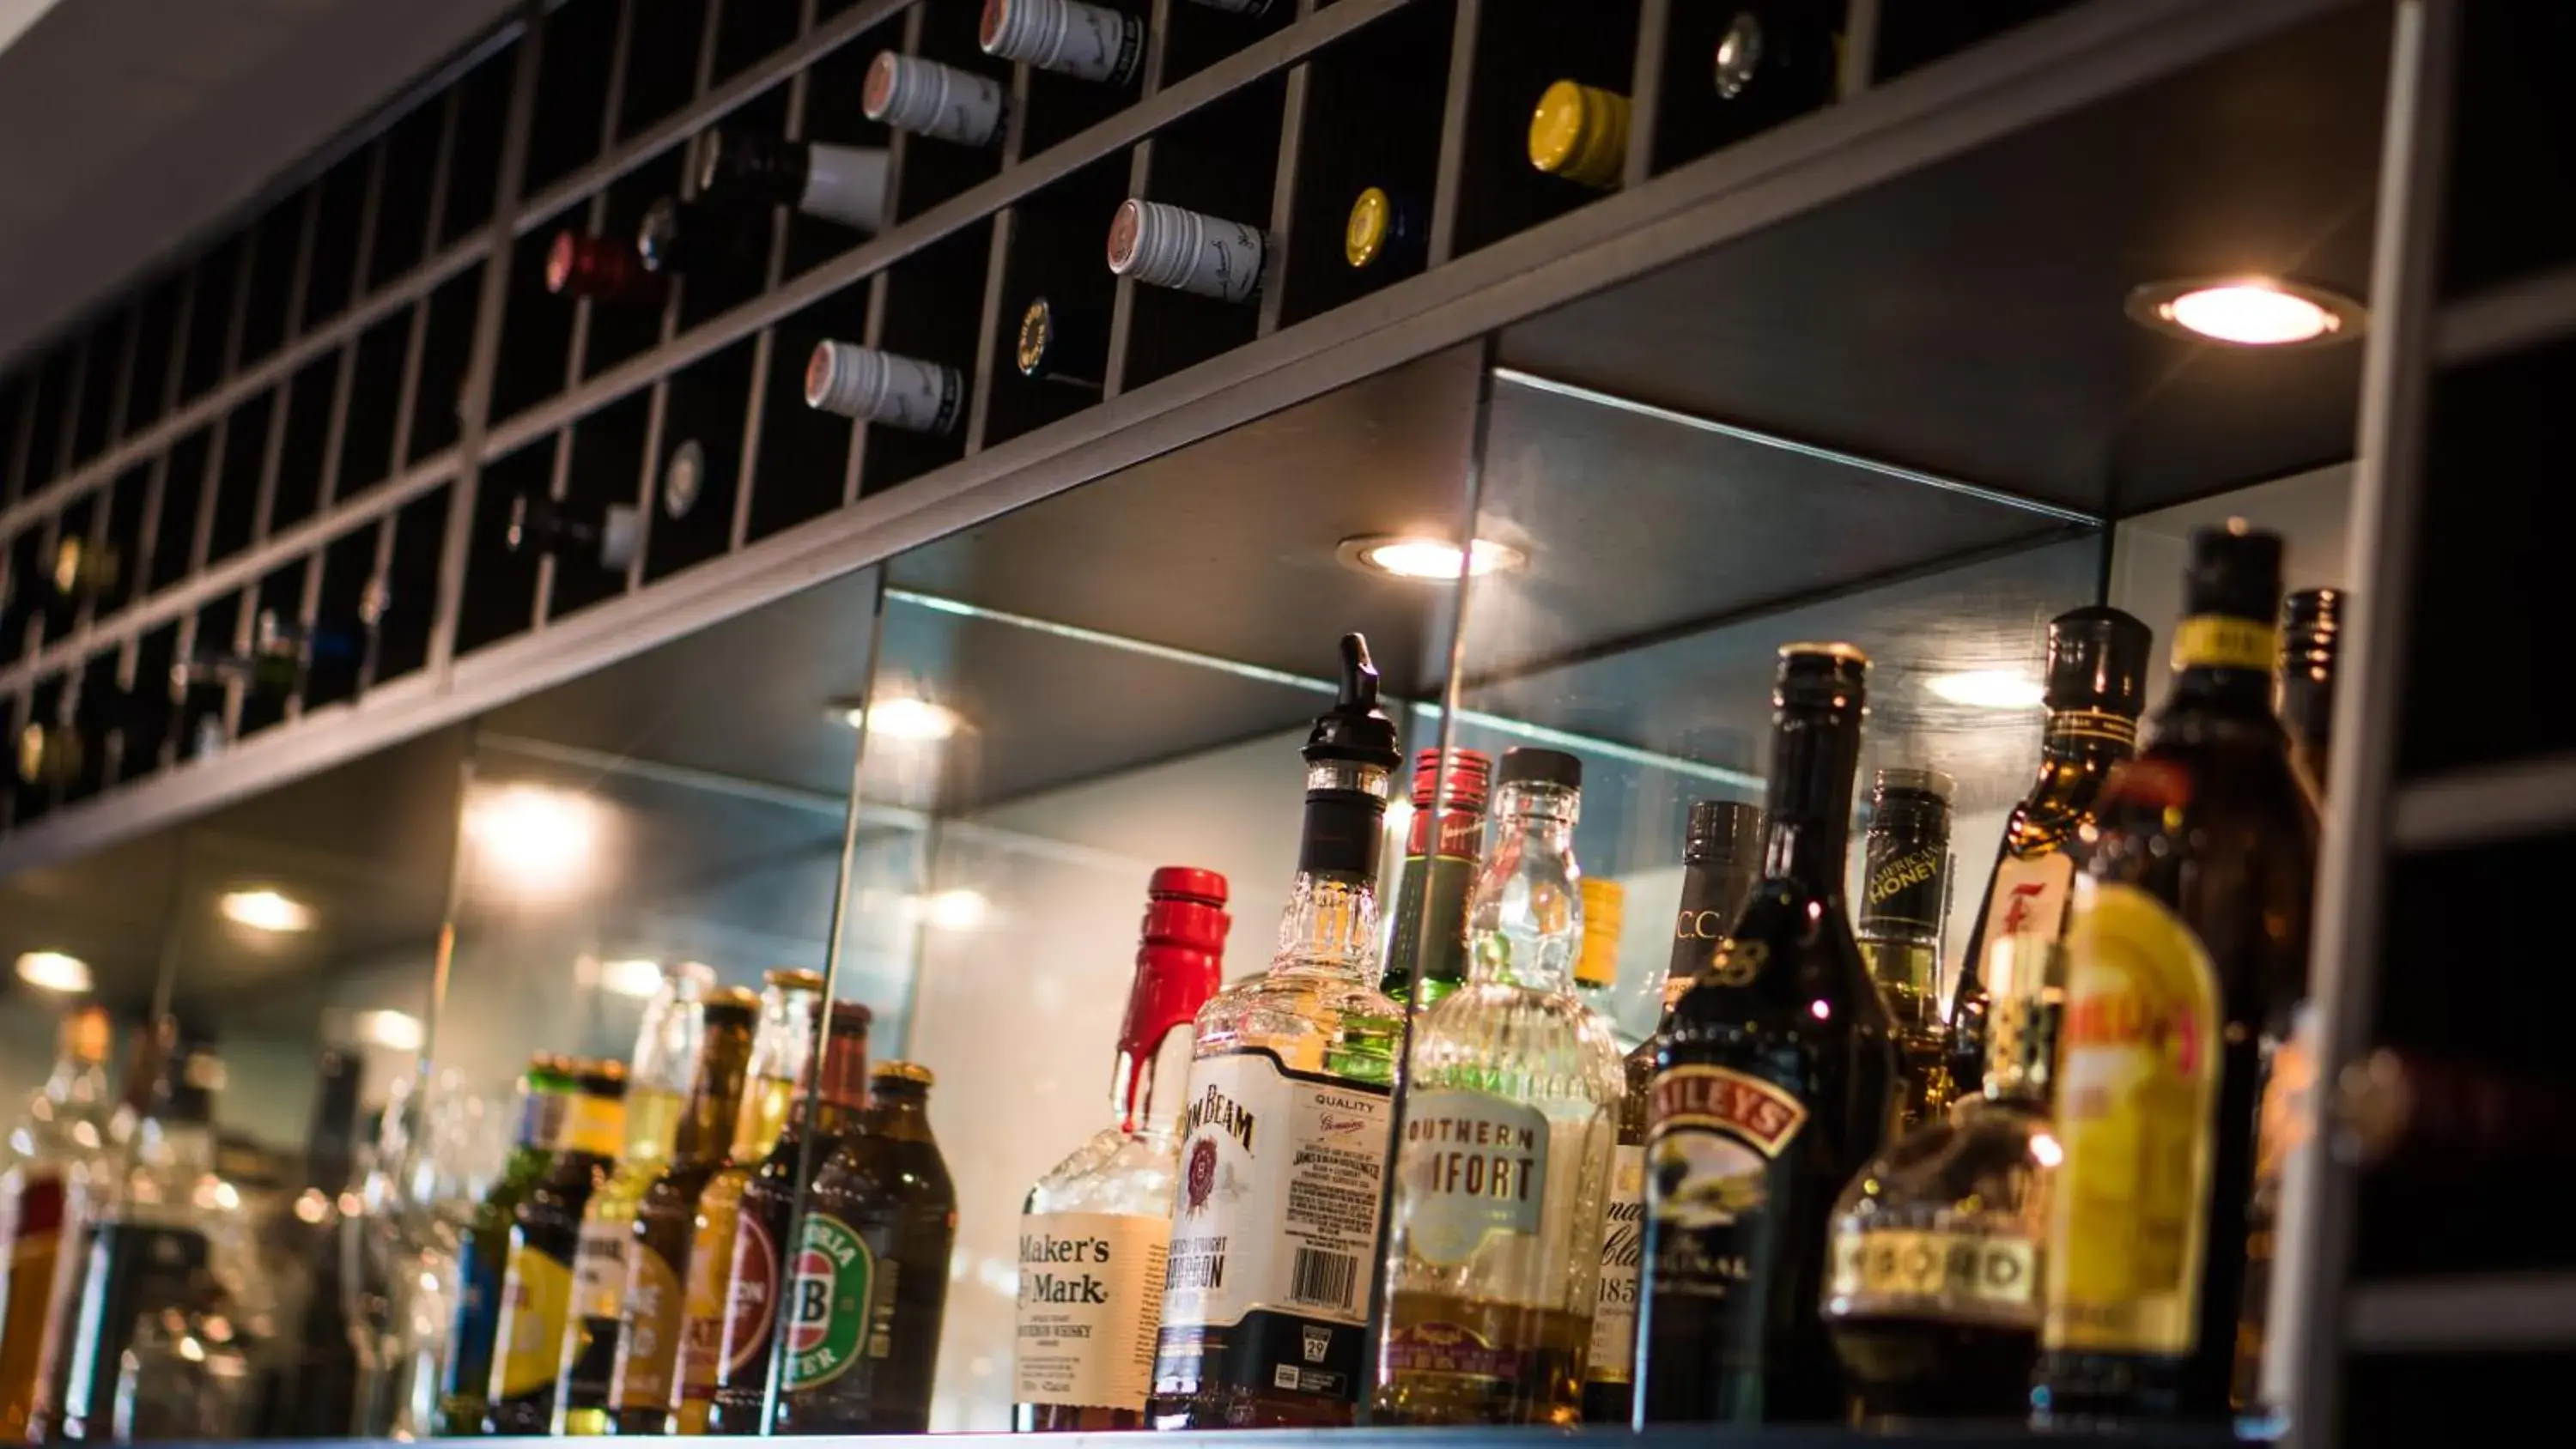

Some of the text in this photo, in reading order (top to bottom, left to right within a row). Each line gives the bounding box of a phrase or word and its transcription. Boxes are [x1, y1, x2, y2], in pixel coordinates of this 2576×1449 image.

[1869, 858, 1938, 905] HONEY
[1203, 1083, 1255, 1152] BEAM
[1315, 1094, 1375, 1113] QUALITY
[1408, 1118, 1534, 1151] OUTHERN
[1432, 1151, 1534, 1205] FORT
[1018, 1233, 1110, 1264] Maker's
[1599, 1277, 1636, 1303] 185
[1307, 1341, 1325, 1354] 29
